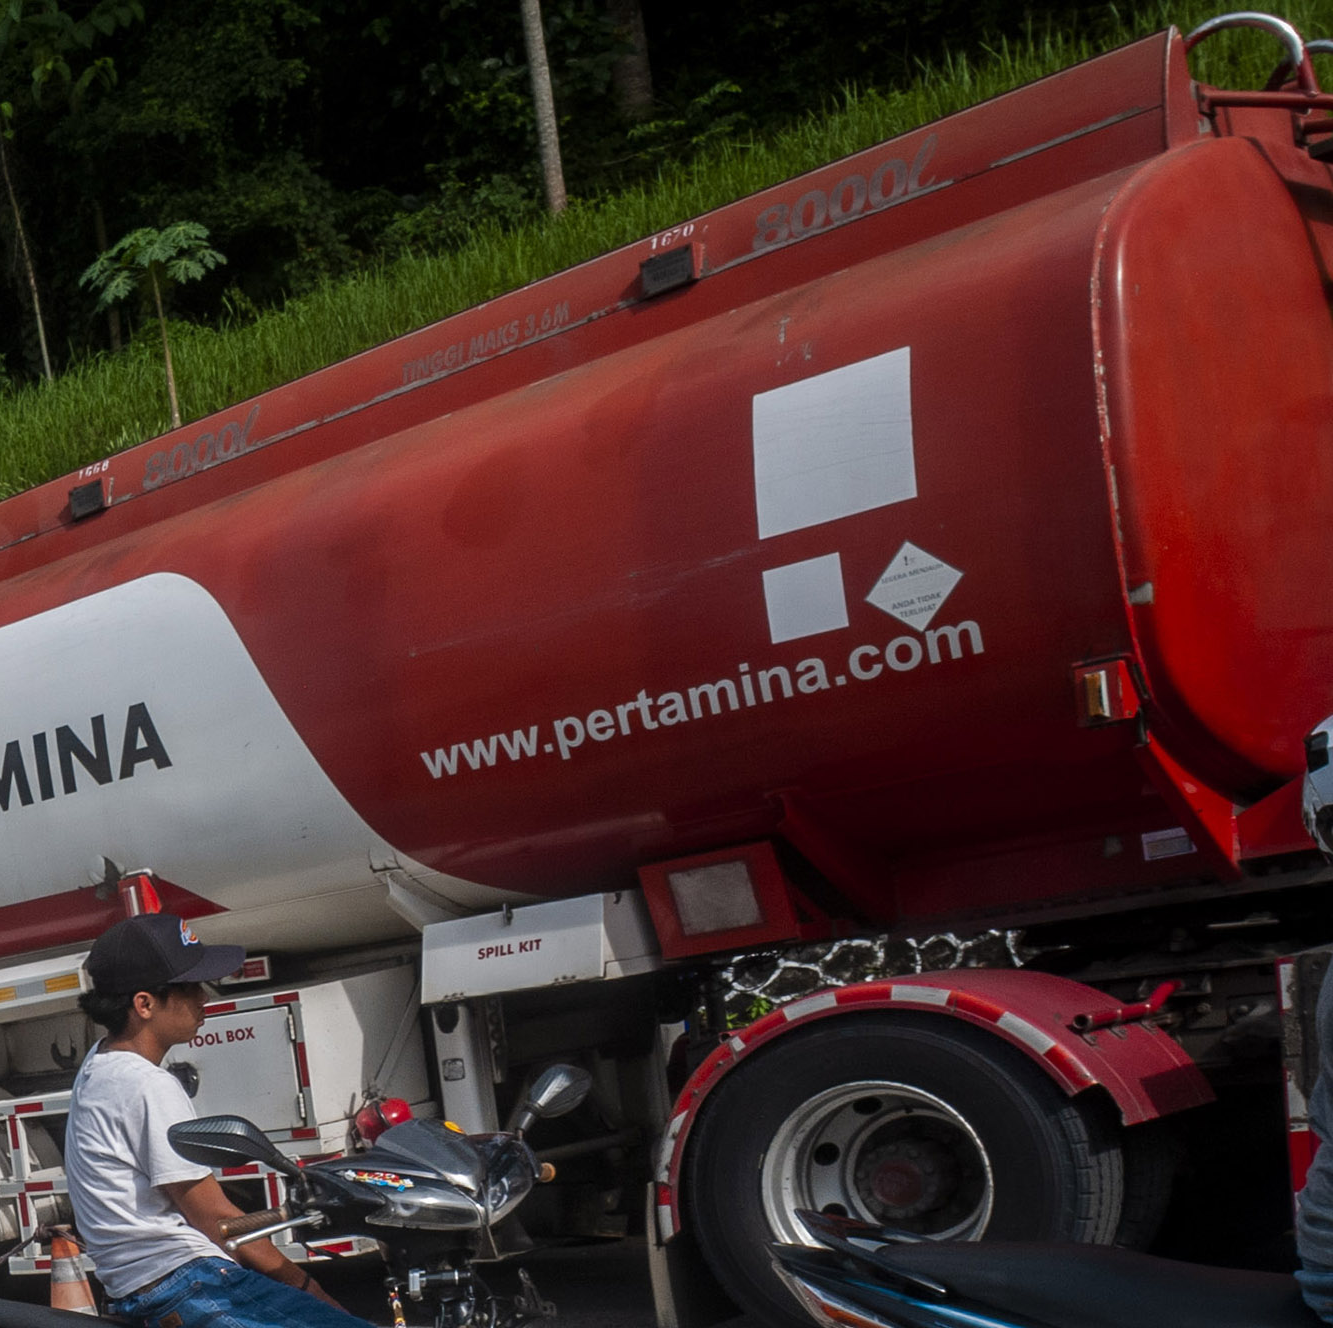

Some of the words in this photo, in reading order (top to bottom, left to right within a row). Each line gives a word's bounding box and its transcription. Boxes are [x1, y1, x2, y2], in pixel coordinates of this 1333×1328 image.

[402, 343, 464, 384] TINGGI
[468, 319, 520, 359] MAKS
[420, 620, 985, 779] www.pertamina.com
[478, 943, 514, 960] SPILL
[519, 938, 542, 953] KIT
[226, 1026, 255, 1042] BOX
